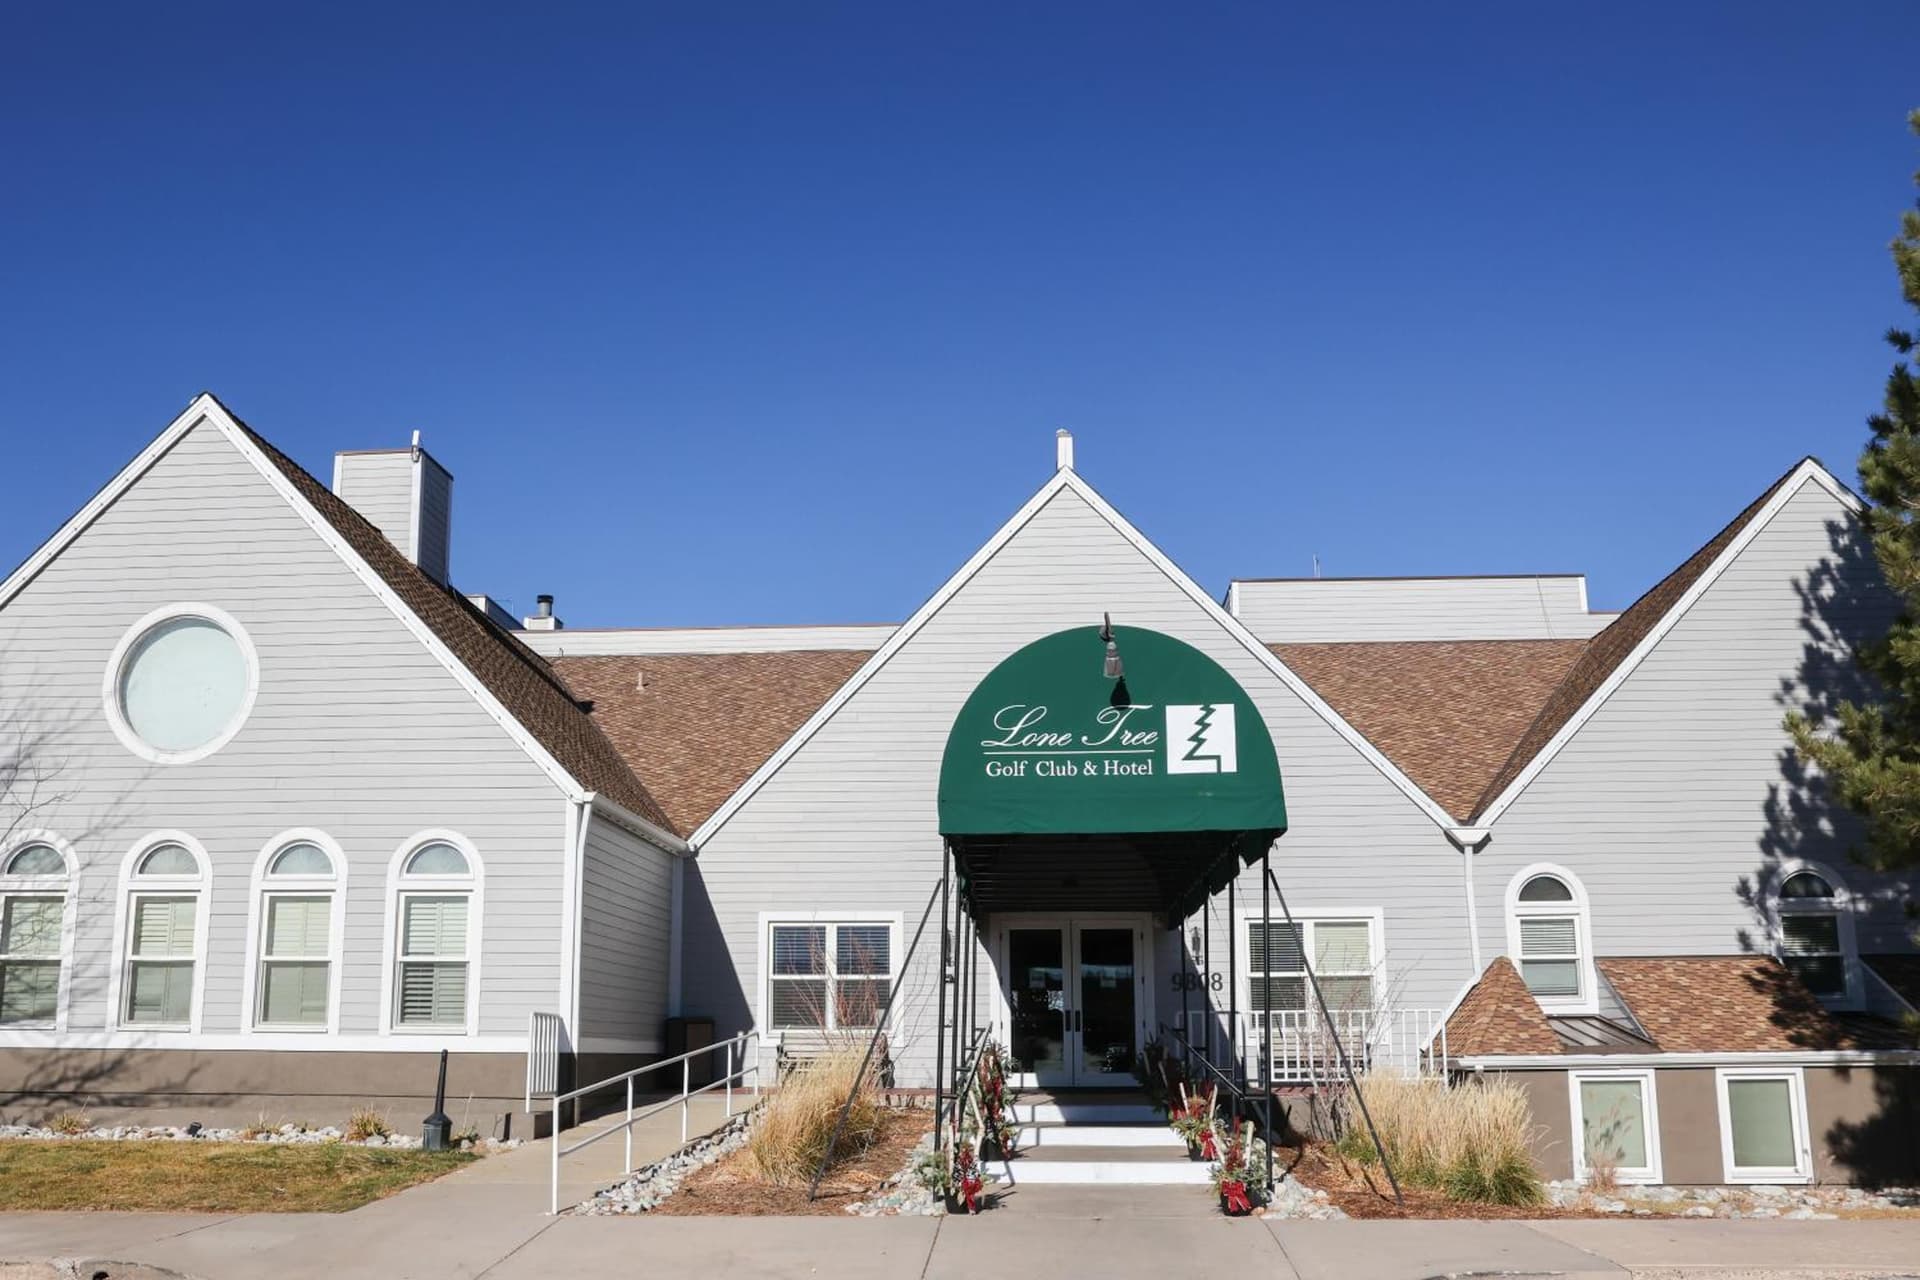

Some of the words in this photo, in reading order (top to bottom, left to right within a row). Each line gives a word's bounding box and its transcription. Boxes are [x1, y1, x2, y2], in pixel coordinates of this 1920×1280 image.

[980, 704, 1073, 747] Lone
[1081, 704, 1159, 746] Tree
[985, 760, 1028, 777] Golf
[1035, 760, 1078, 777] Club
[1083, 761, 1098, 776] &
[1103, 759, 1153, 776] Hotel
